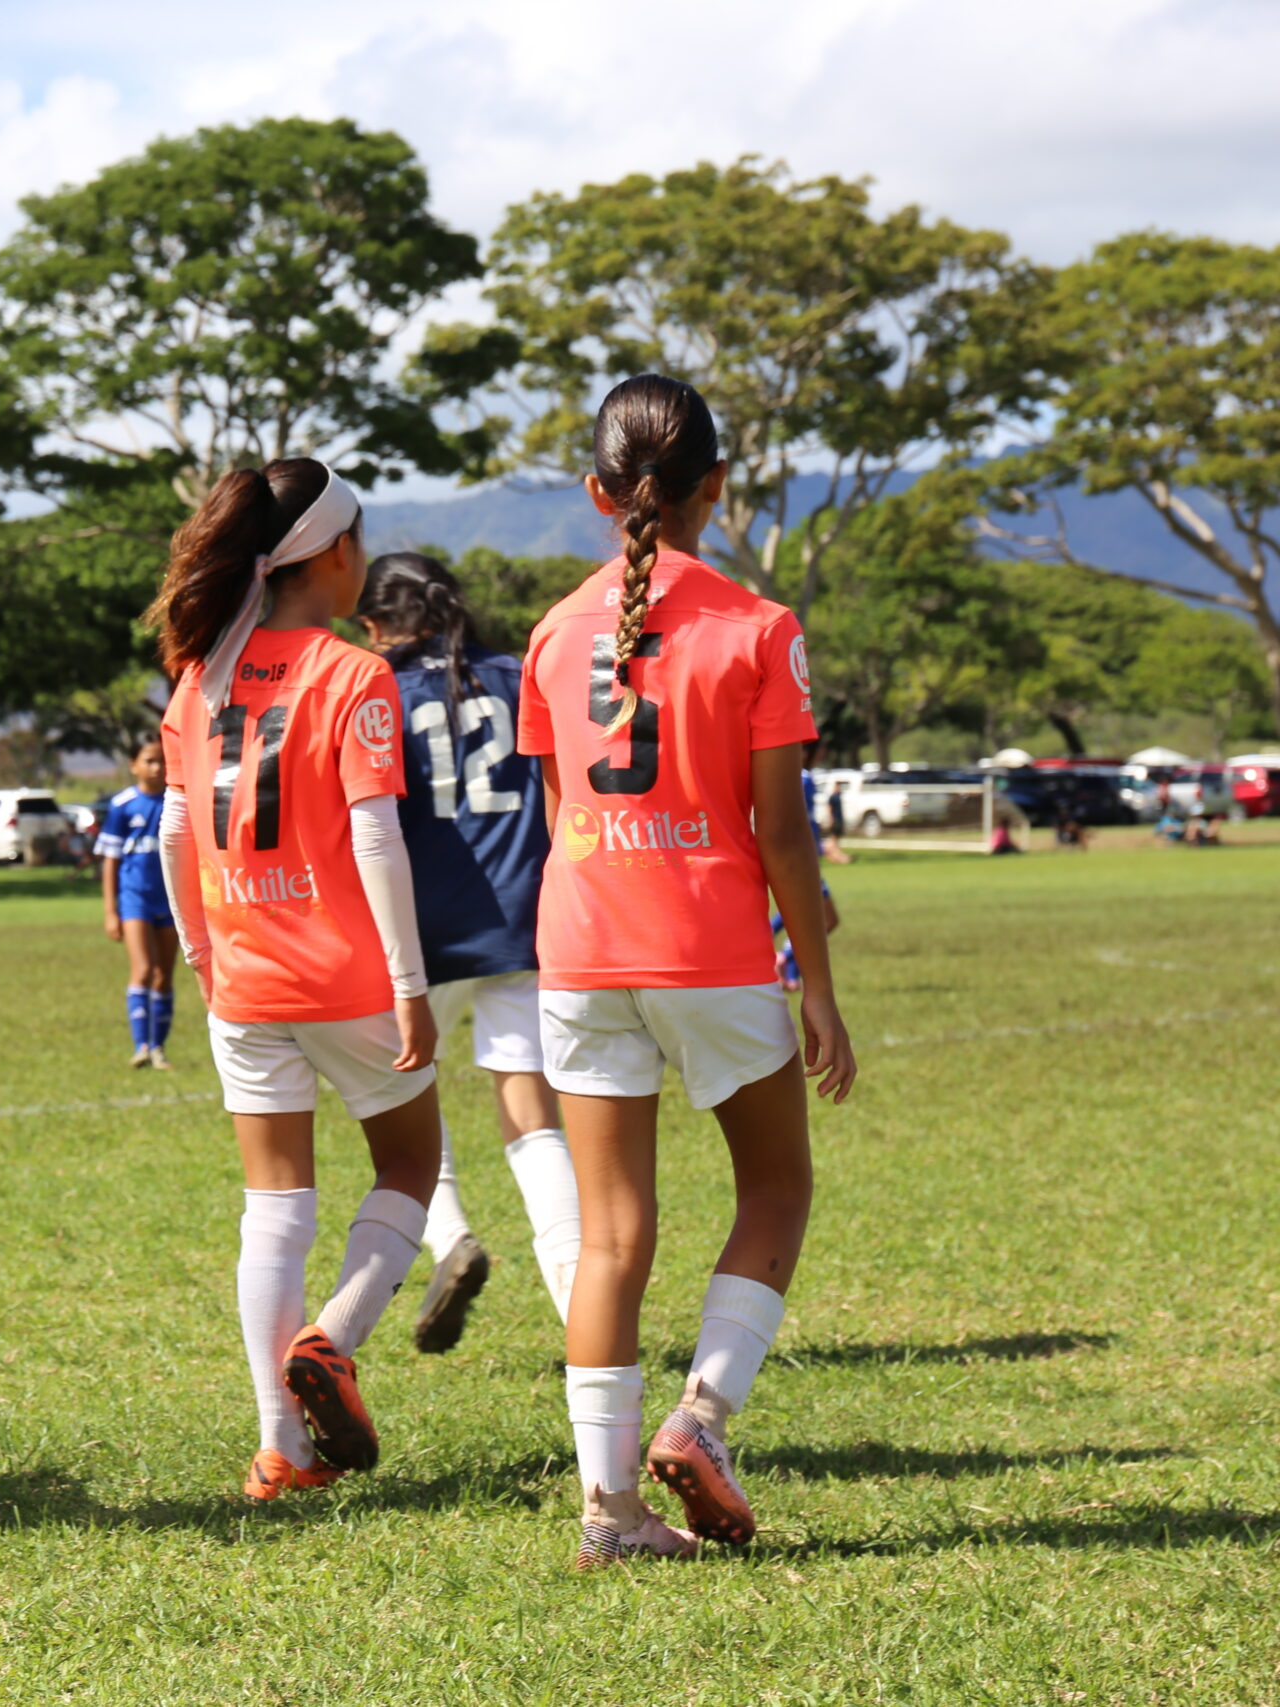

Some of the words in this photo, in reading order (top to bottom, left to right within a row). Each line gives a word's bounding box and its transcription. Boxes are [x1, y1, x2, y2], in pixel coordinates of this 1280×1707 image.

[411, 696, 521, 818] 12
[587, 632, 663, 795] 5
[208, 705, 288, 851] 11
[602, 811, 711, 850] Kuilei
[222, 864, 319, 903] Kuilei
